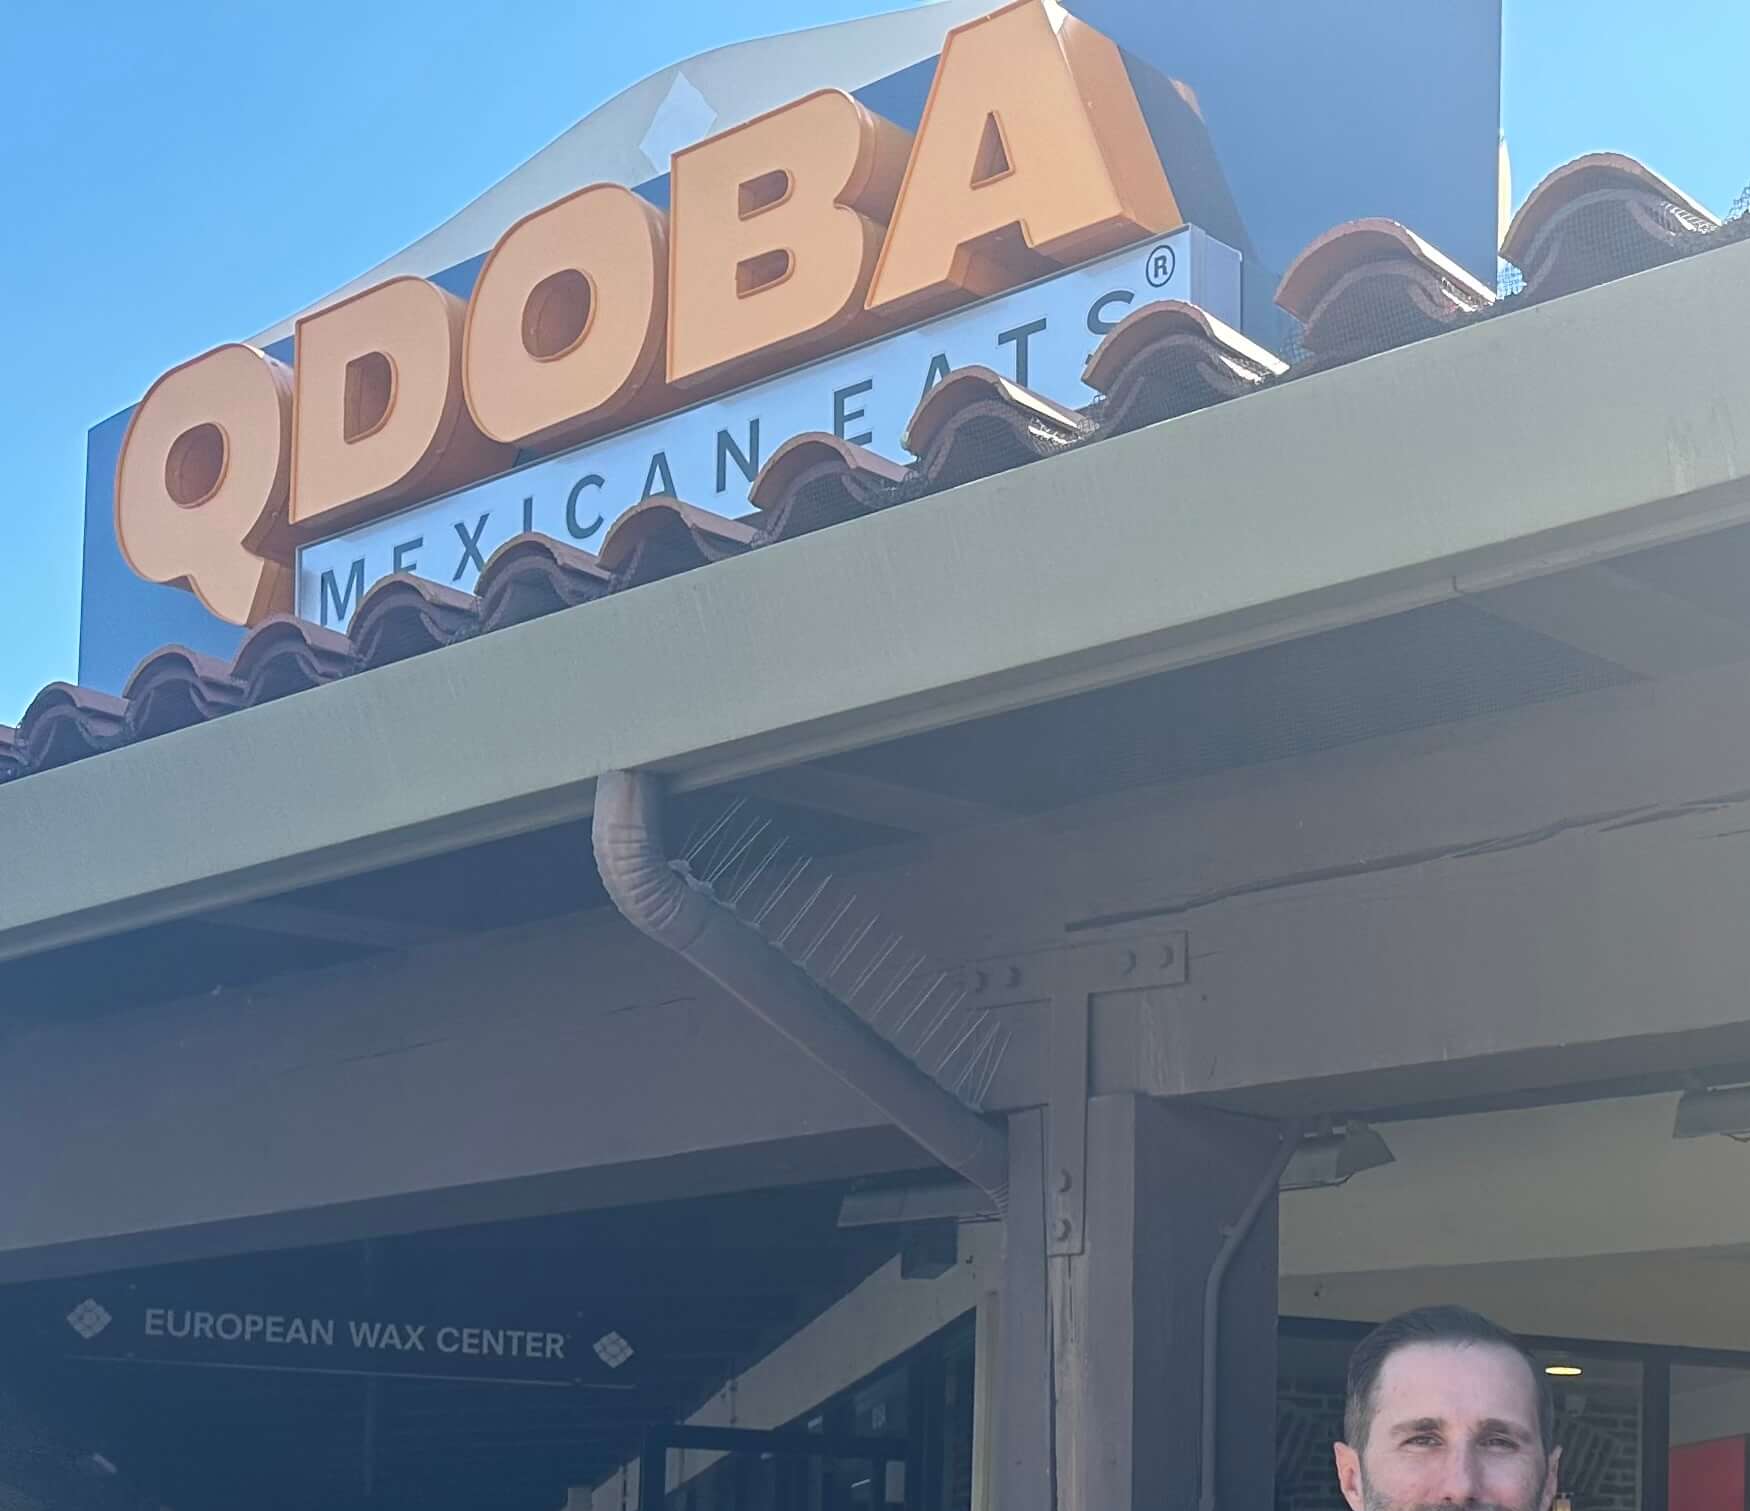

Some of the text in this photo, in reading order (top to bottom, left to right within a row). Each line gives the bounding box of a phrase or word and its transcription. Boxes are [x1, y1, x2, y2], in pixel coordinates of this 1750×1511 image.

[114, 0, 1180, 627] QDOBA
[319, 418, 761, 627] MEXICAN
[144, 1308, 566, 1359] EUROPEAN WAX CENTER
